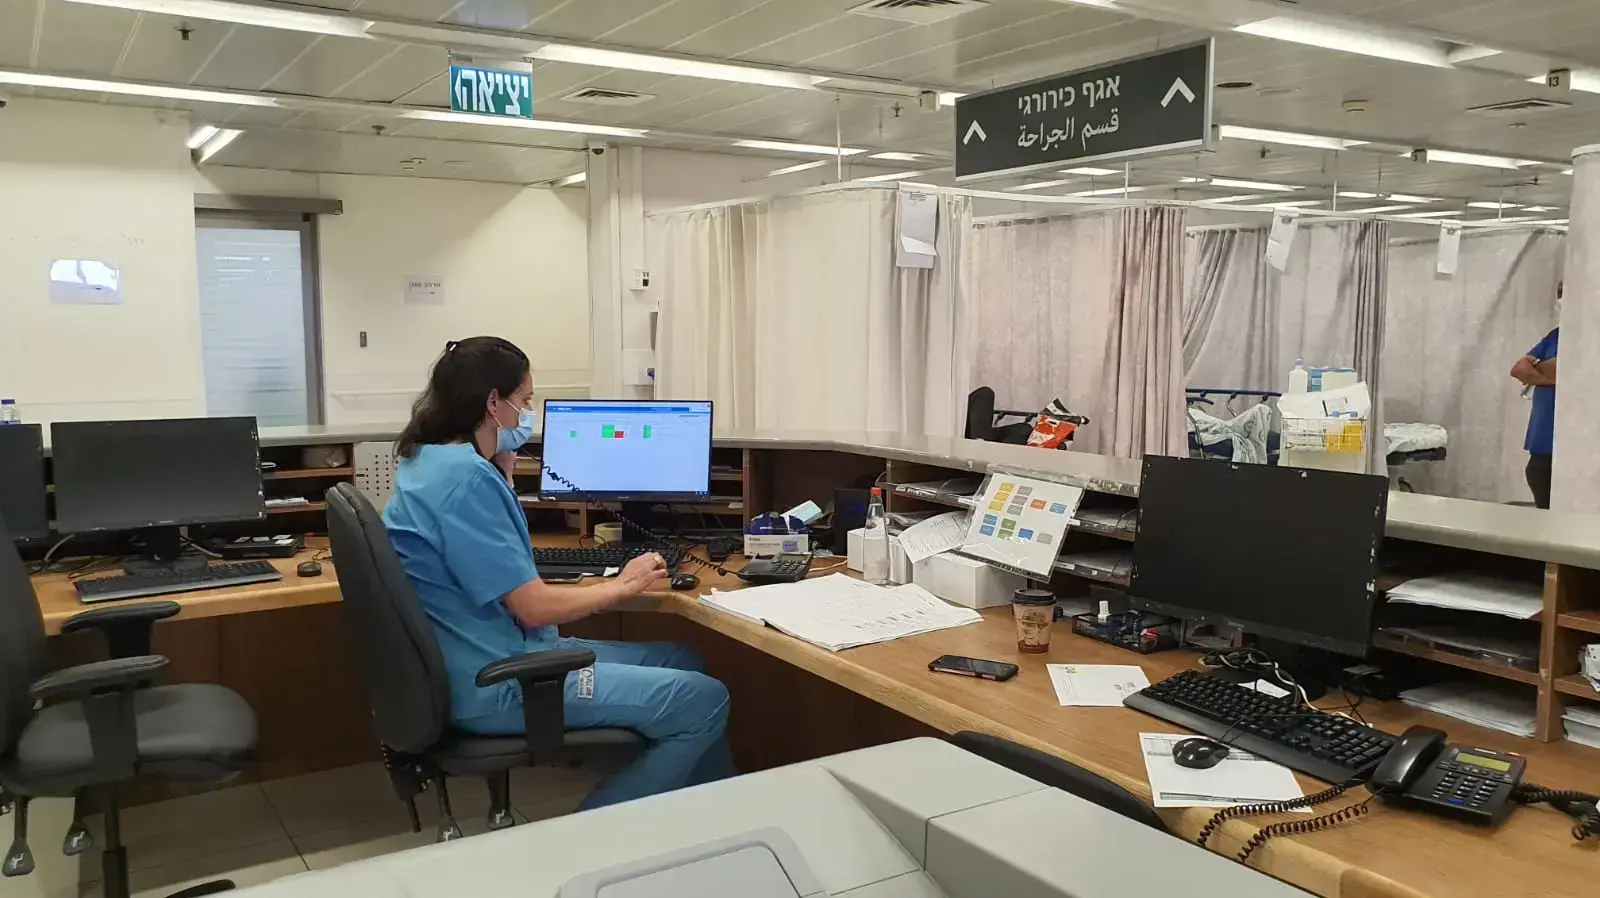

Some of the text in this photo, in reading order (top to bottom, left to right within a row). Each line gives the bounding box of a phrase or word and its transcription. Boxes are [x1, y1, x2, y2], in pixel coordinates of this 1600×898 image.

[461, 69, 529, 115] יציאה
[1018, 75, 1120, 115] אגף כירורגי
[1549, 76, 1560, 88] 13
[1017, 107, 1119, 152] قسم الجراحة
